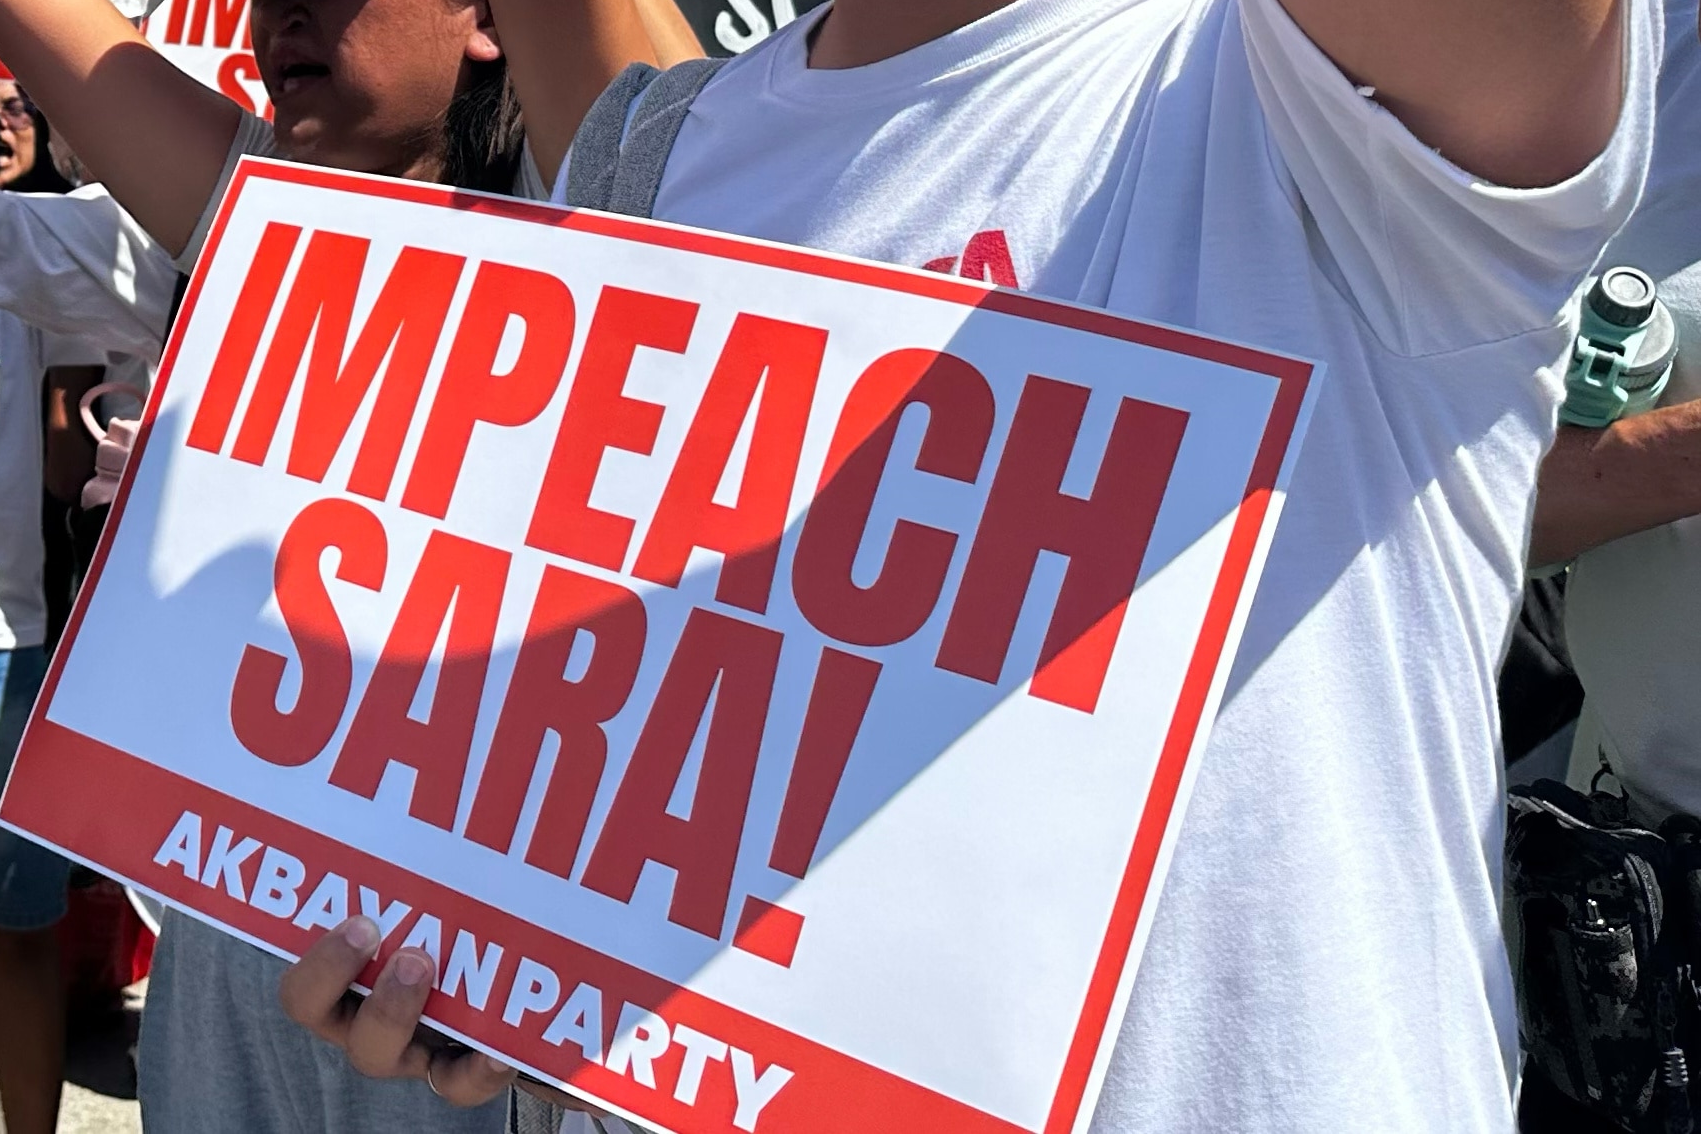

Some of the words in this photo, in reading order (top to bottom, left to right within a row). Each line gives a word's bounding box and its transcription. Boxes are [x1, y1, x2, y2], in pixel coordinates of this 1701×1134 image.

[185, 221, 1190, 714] IMPEACH
[229, 497, 883, 969] SARA!
[153, 810, 504, 1011] AKBAYAN
[502, 963, 795, 1133] PARTY
